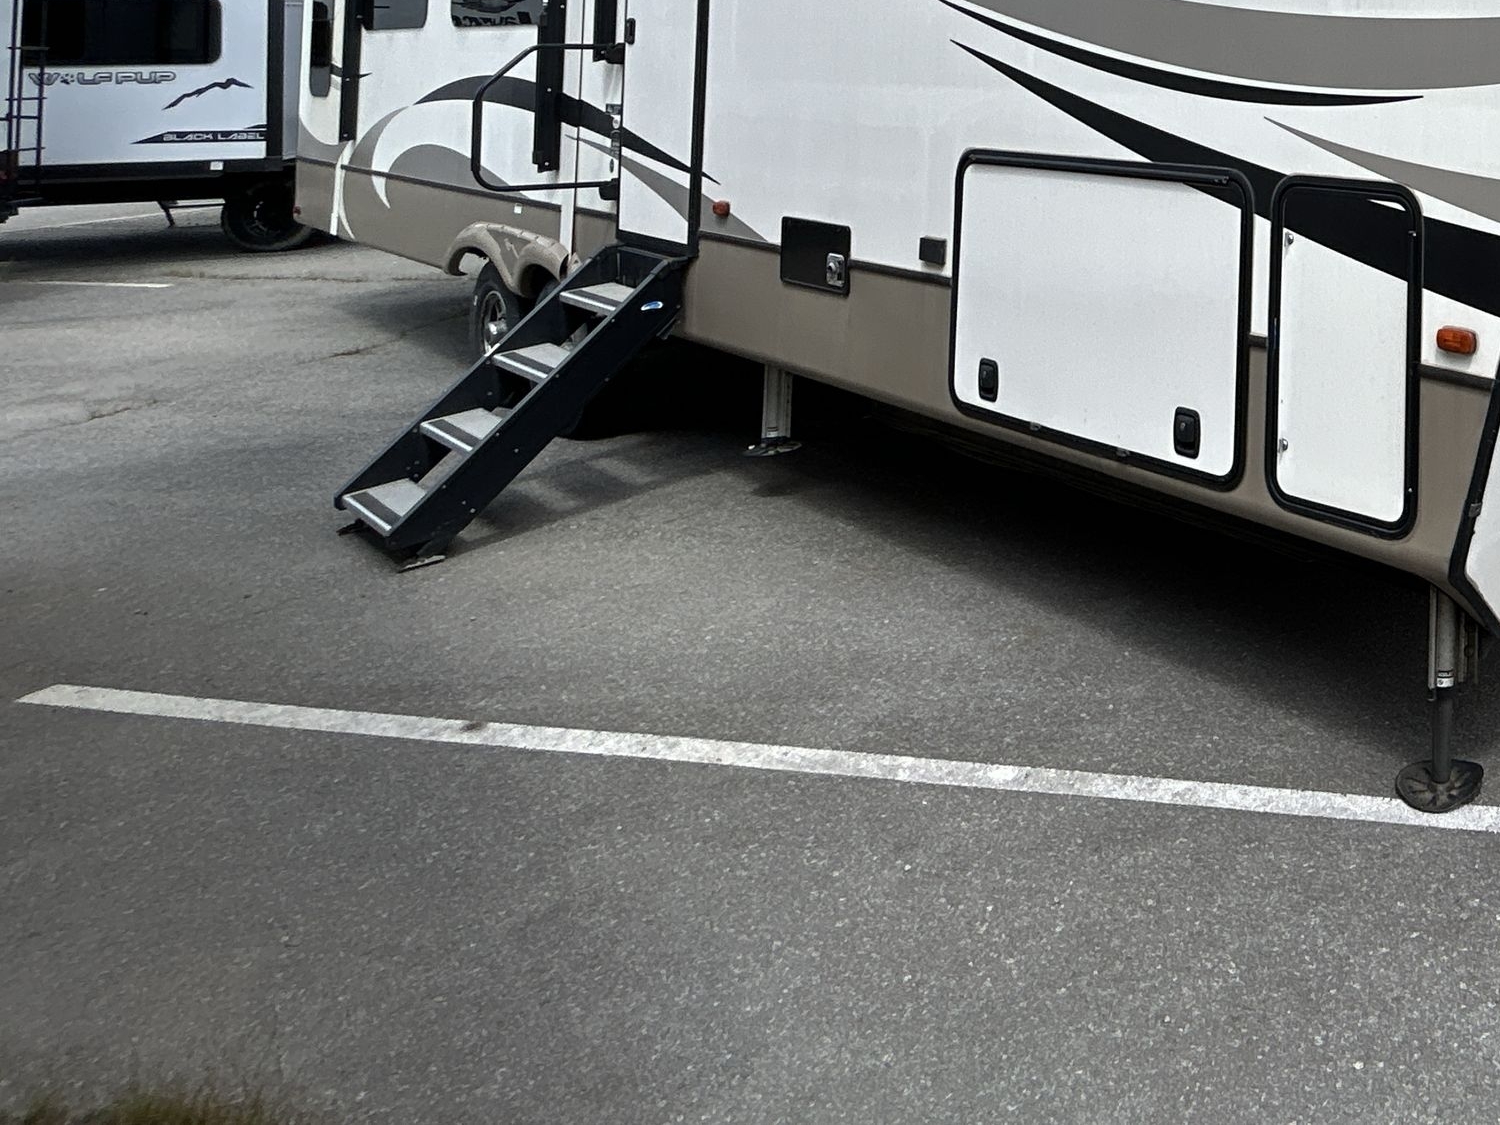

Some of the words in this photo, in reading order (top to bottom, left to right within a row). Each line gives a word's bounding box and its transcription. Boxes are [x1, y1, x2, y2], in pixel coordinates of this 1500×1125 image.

[115, 71, 177, 85] PUP
[163, 132, 214, 142] BLACK
[217, 131, 265, 141] LABEL
